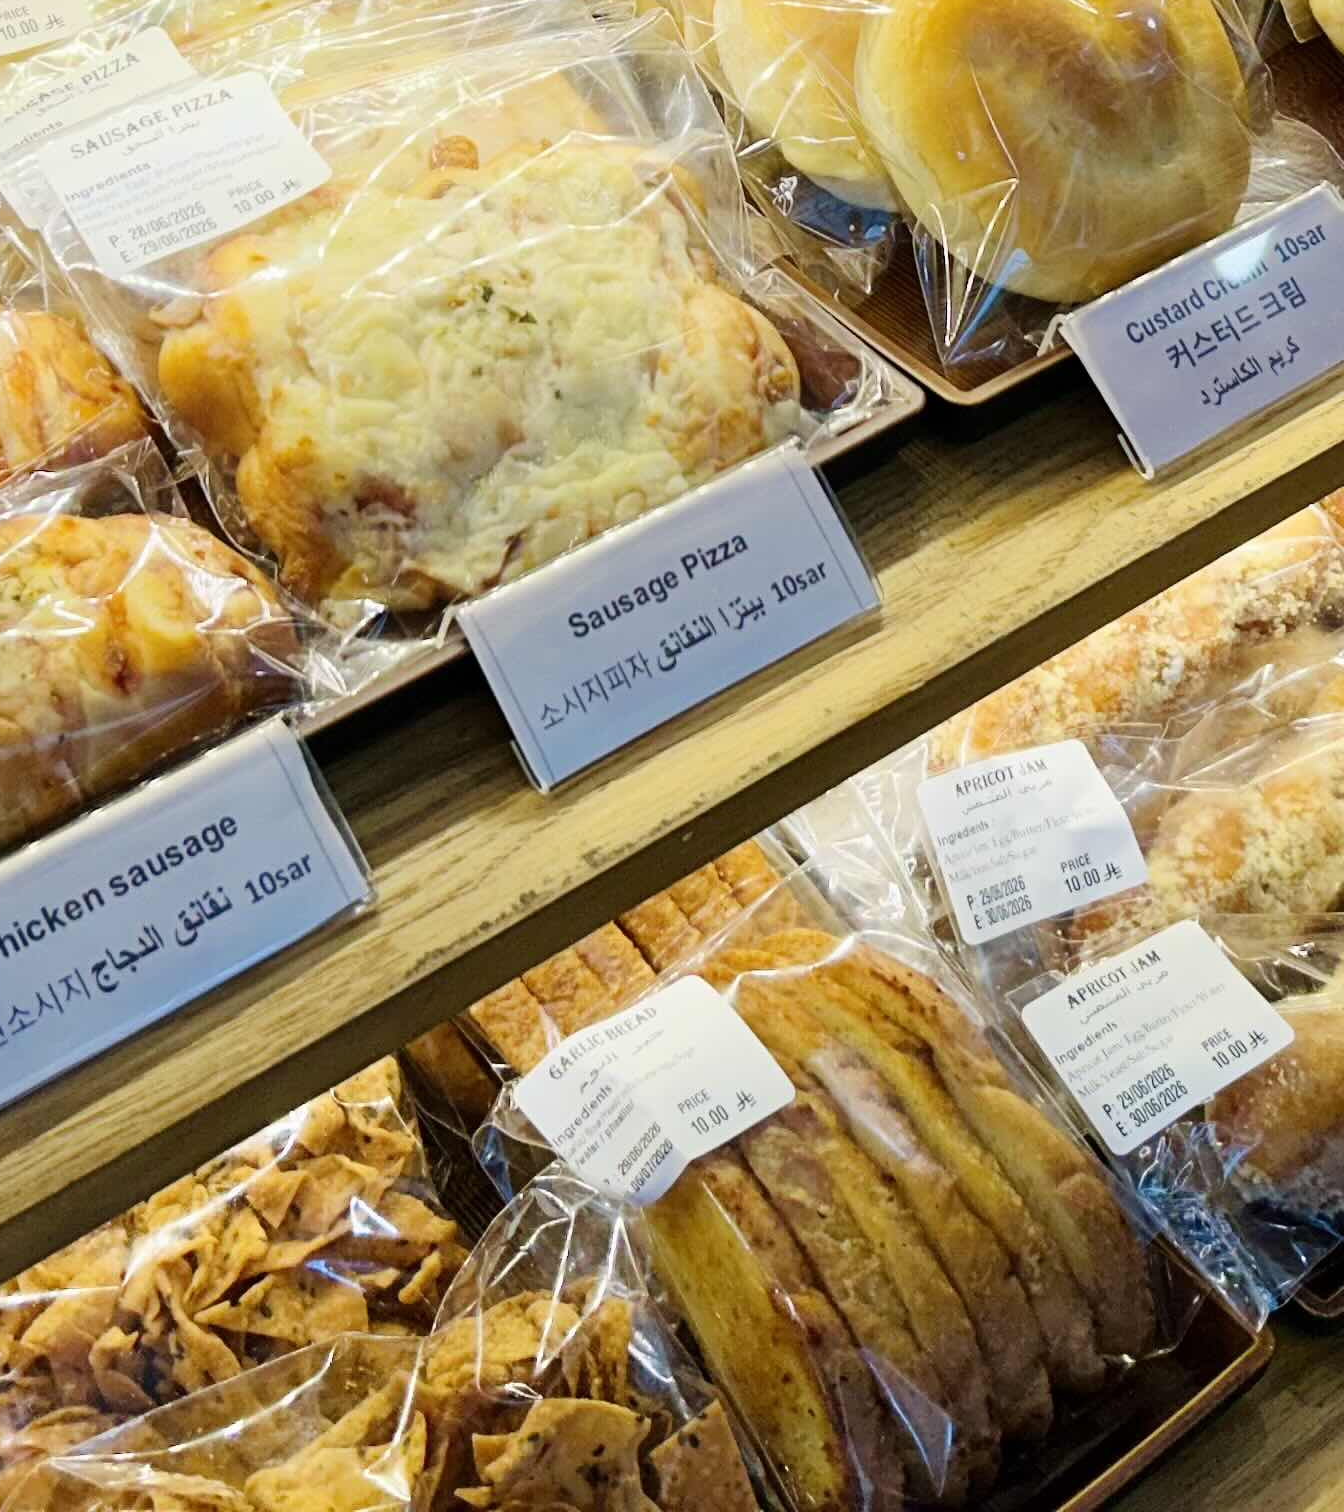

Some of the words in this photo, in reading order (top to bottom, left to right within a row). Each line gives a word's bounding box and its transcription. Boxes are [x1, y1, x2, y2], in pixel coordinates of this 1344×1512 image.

[0, 19, 40, 41] 10.00
[81, 51, 142, 87] PIZZA
[69, 109, 169, 161] SAUSAGE
[170, 87, 234, 117] PIZZA
[231, 190, 276, 216] 10.00
[1125, 288, 1205, 344] Custard
[1273, 221, 1327, 264] 10sar
[1165, 306, 1262, 368] 커스터드
[1259, 277, 1307, 319] 크림
[1268, 336, 1302, 376] كريم
[567, 569, 681, 640] Sausage
[680, 533, 749, 579] Pizza
[540, 650, 654, 731] 소시지피자
[769, 559, 829, 605] 10sar
[955, 766, 1017, 799] APRICOT
[107, 813, 239, 898] sausage
[1060, 852, 1091, 873] PRICE
[243, 853, 315, 906] 10sar
[1064, 868, 1102, 894] 10.00
[175, 883, 234, 949] نقانق
[91, 923, 167, 994] الدجاج
[1066, 967, 1129, 1009] APRICOT
[548, 1033, 606, 1081] GARLIC
[606, 1007, 657, 1041] BREAD
[1201, 1027, 1232, 1053] PRICE
[1211, 1041, 1249, 1070] 10.00
[677, 1087, 712, 1115] PRICE
[1116, 1062, 1176, 1110] 29/06/2026
[1132, 1079, 1189, 1128] 30/06/2026
[690, 1104, 730, 1136] 10.00
